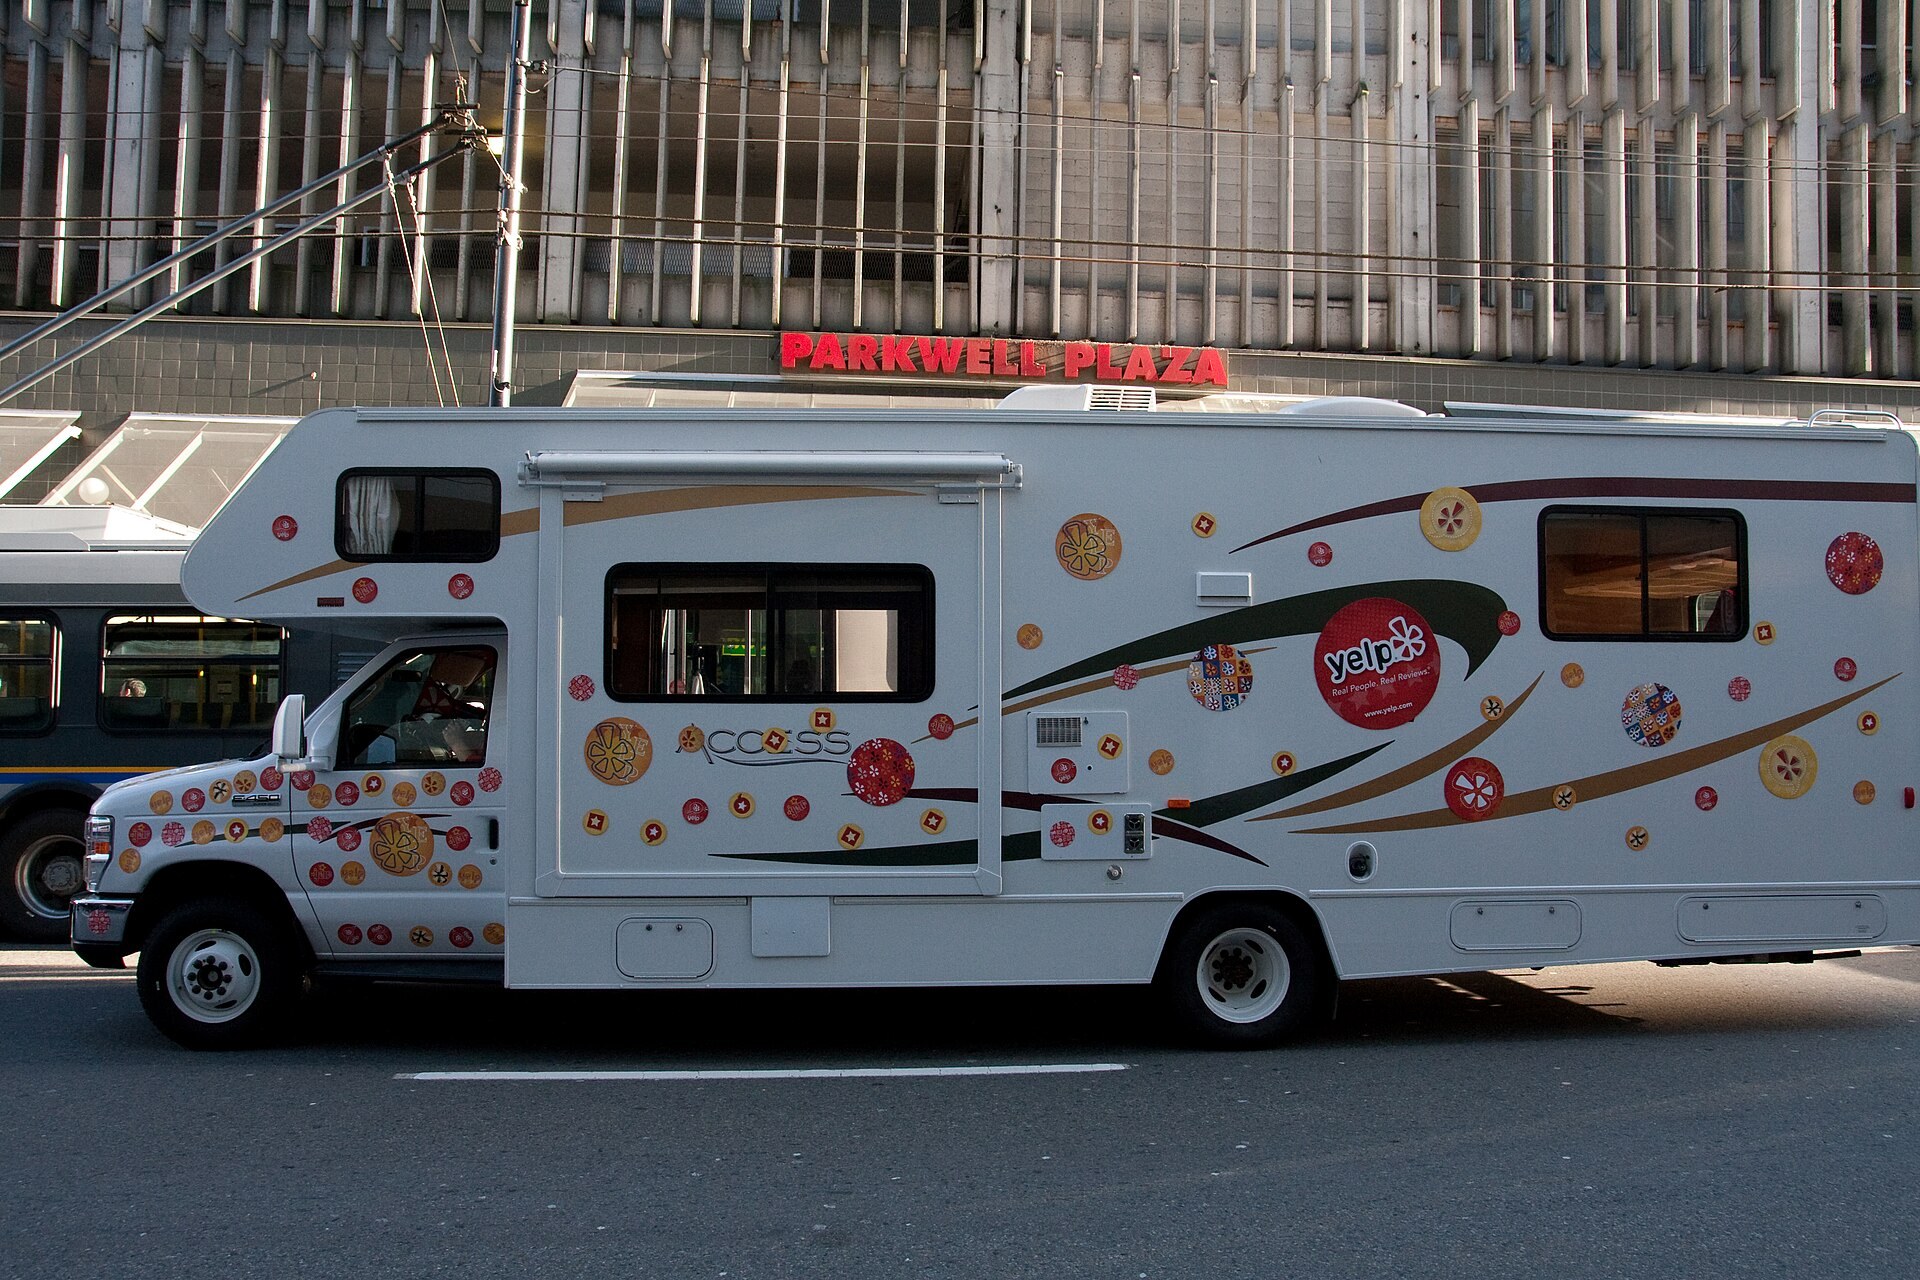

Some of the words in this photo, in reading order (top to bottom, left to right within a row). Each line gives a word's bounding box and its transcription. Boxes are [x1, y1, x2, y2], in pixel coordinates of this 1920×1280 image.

[780, 332, 1046, 377] PARKWELL
[1064, 343, 1227, 385] PLAZA
[1324, 638, 1393, 683] yelp
[1332, 687, 1348, 697] Real
[1350, 680, 1379, 693] People.
[1380, 674, 1396, 685] Real
[1364, 701, 1413, 718] www.yelp.com
